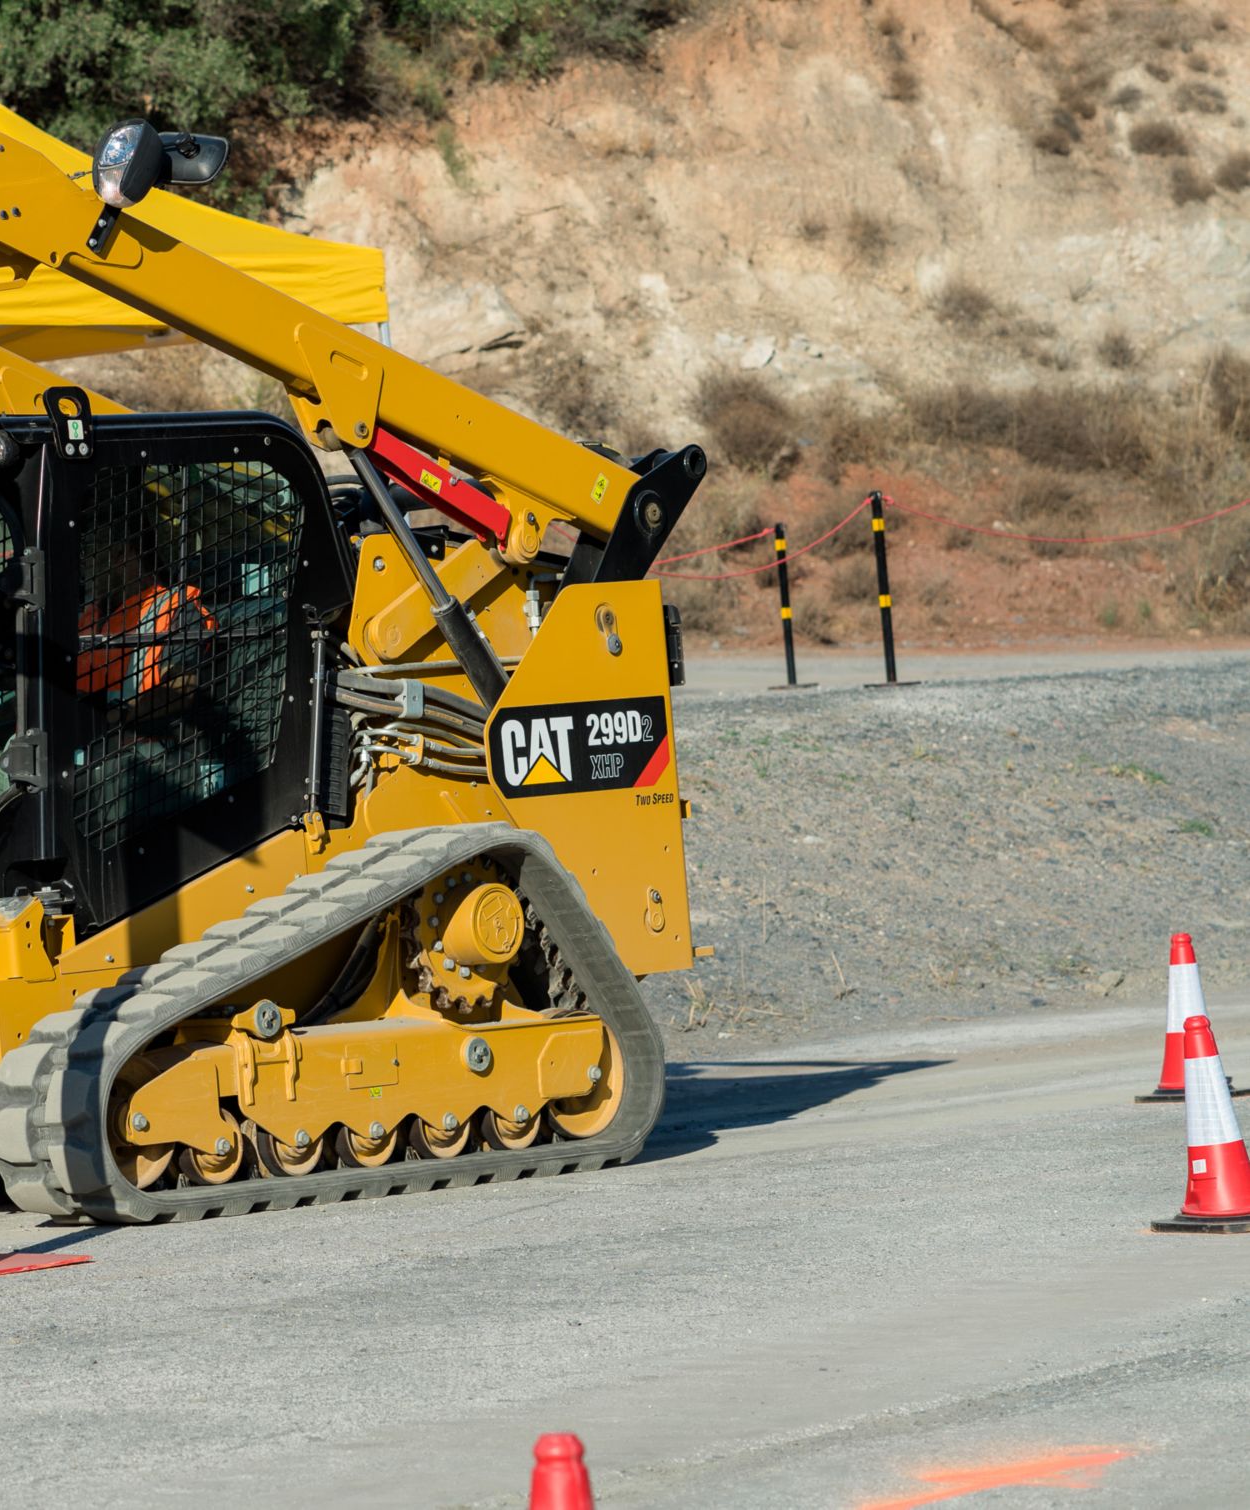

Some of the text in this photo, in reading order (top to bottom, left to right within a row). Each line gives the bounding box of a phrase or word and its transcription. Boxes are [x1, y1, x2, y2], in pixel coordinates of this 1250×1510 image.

[586, 710, 654, 747] 299D2
[500, 715, 574, 787] CAT
[590, 753, 624, 780] XHP
